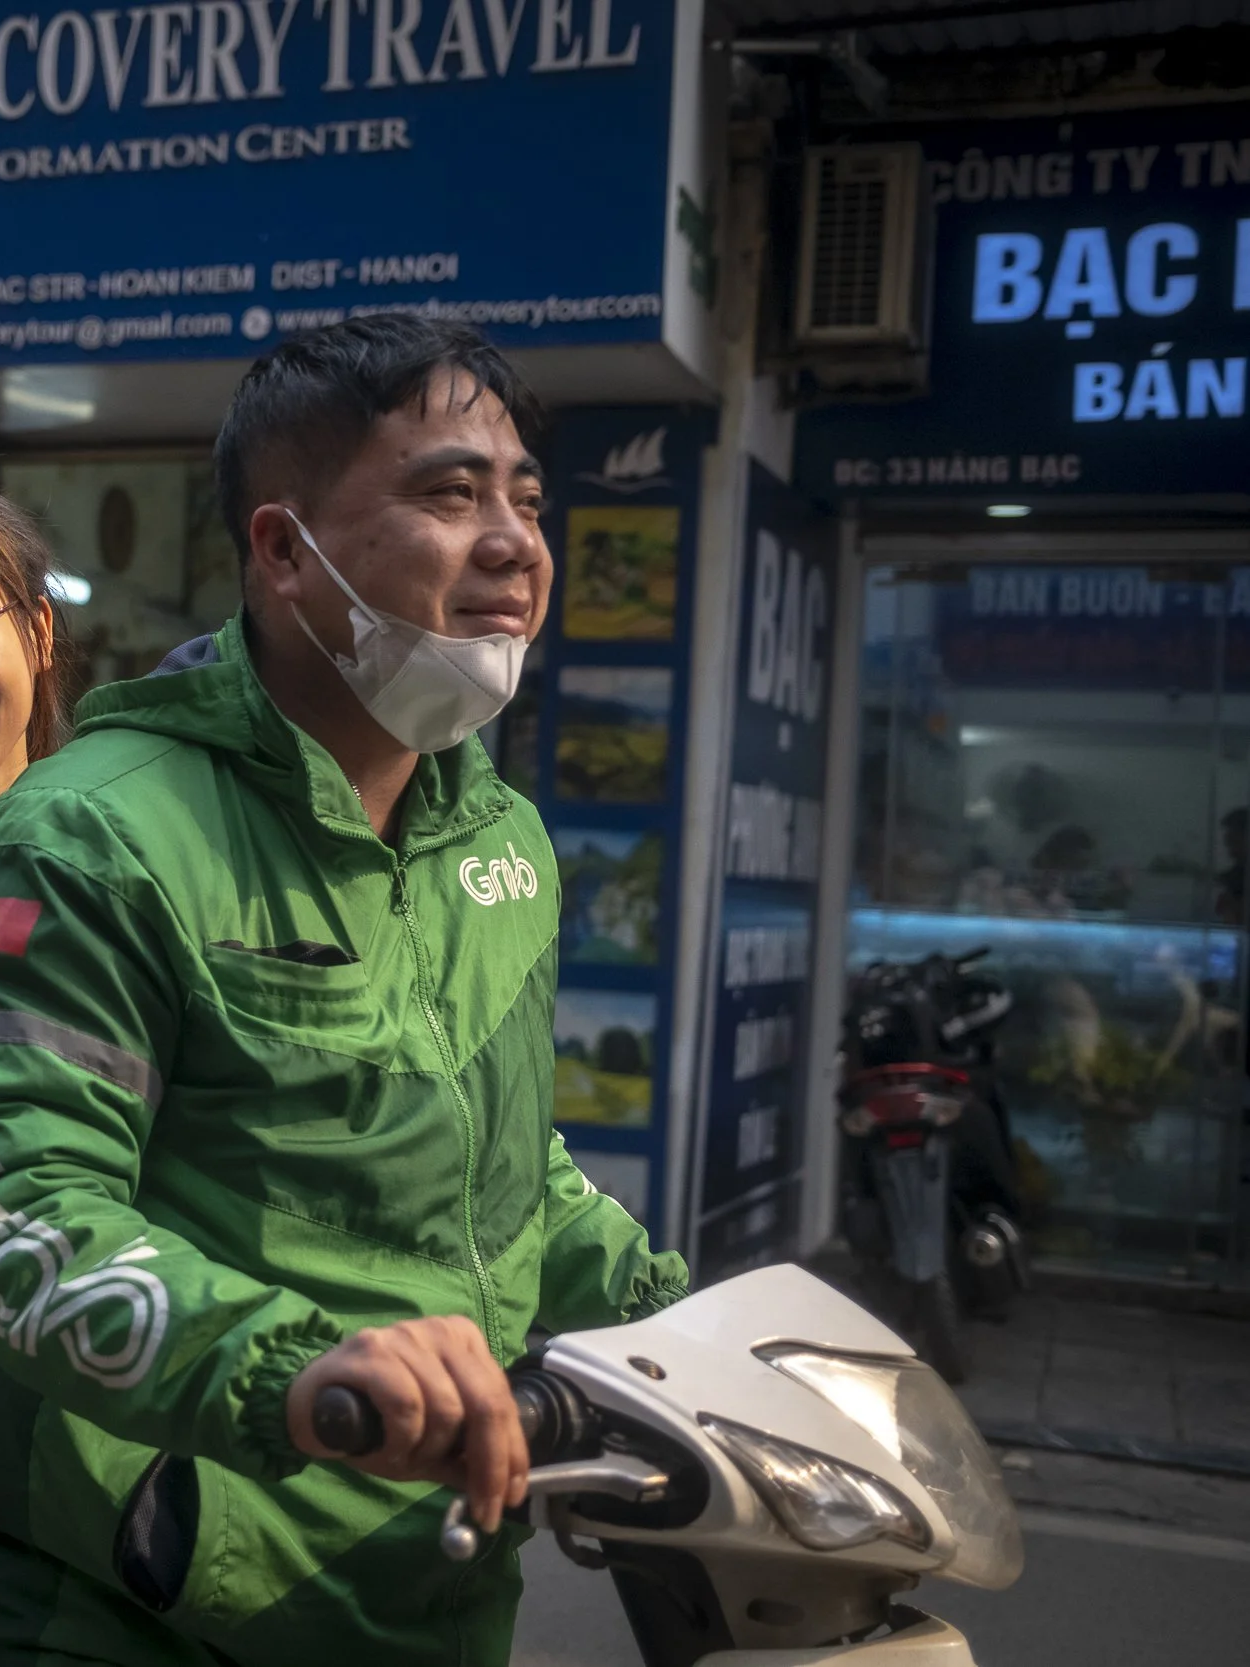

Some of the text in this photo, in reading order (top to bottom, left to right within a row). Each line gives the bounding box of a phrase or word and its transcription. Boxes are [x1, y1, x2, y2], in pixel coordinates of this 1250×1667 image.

[313, 0, 642, 92] TRAVEL
[235, 116, 411, 163] CENTER
[926, 146, 1075, 203] CÔNG
[1086, 144, 1161, 195] TY
[28, 271, 87, 304] STR
[98, 267, 180, 300] HOAN
[181, 263, 256, 294] KIEM
[270, 259, 342, 291] DIST
[358, 252, 460, 285] HANOI
[971, 221, 1201, 339] BẠC
[1072, 341, 1248, 422] BÁN
[459, 841, 538, 907] Grab
